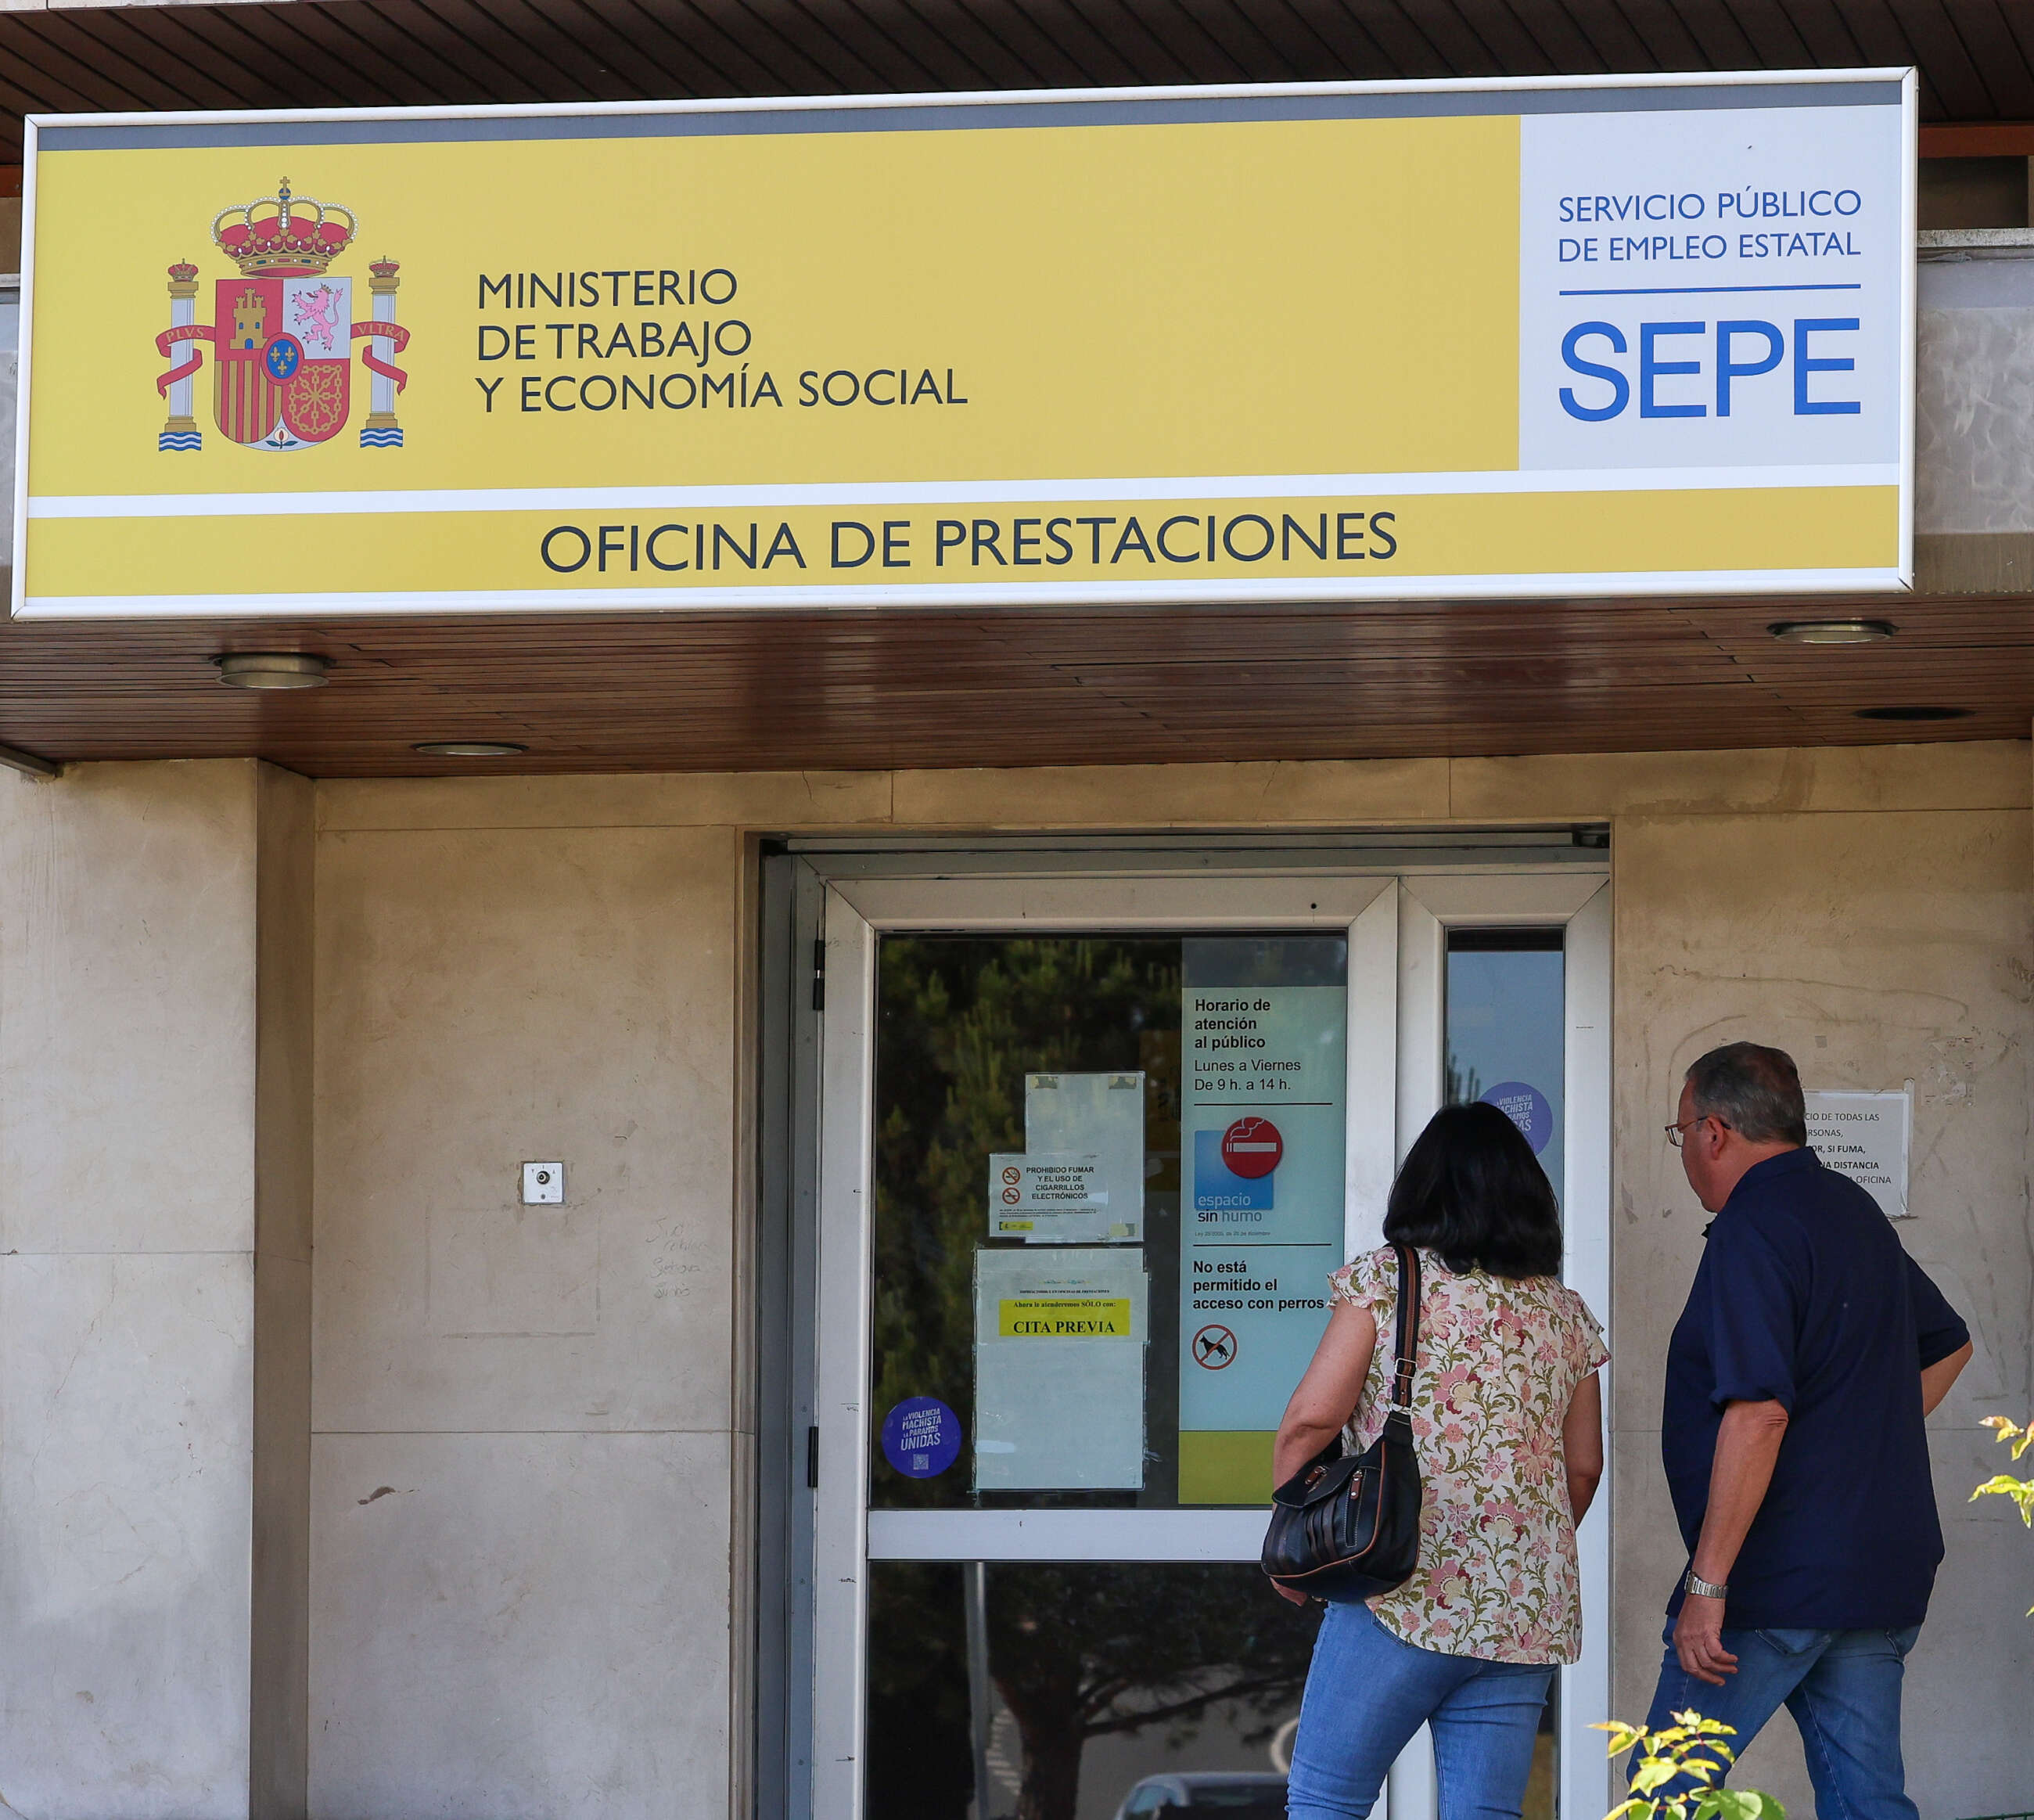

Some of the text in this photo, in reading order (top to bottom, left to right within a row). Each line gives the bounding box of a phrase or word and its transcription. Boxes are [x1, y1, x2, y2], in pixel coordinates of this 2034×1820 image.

[1559, 185, 1862, 222] SERVICIO PÚBLICO
[1559, 231, 1862, 262] DE EMPLEO ESTATAL
[479, 268, 737, 309] MINISTERIO
[166, 327, 204, 343] PLVS
[357, 323, 404, 340] VLTRA
[478, 319, 752, 368] DE TRABAJO
[1559, 318, 1861, 422] SEPE
[476, 363, 968, 412] Y ECONOMÍA SOCIAL
[541, 511, 1397, 573] OFICINA DE PRESTACIONES
[1195, 998, 1270, 1012] Horario de
[1195, 1017, 1257, 1030] atención
[1195, 1035, 1266, 1051] al público
[1195, 1059, 1301, 1071] Lunes a Viernes
[1195, 1078, 1291, 1090] De 9 h. a 14 h.
[1808, 1128, 1844, 1138] RSONAS,
[1837, 1145, 1866, 1154] FUMA,
[1856, 1175, 1892, 1184] OFICINA
[1031, 1191, 1088, 1200] ELECTRÓNICOS
[1198, 1192, 1251, 1209] espacio
[1198, 1210, 1262, 1222] sin humo
[1193, 1261, 1247, 1273] No está
[1193, 1279, 1278, 1293] permitido el
[1193, 1299, 1324, 1311] acceso con perros
[1013, 1320, 1116, 1333] CITA PREVIA
[908, 1408, 940, 1419] VIOLENCIA
[902, 1415, 942, 1430] MACHISTA
[900, 1432, 941, 1451] UNIDAS
